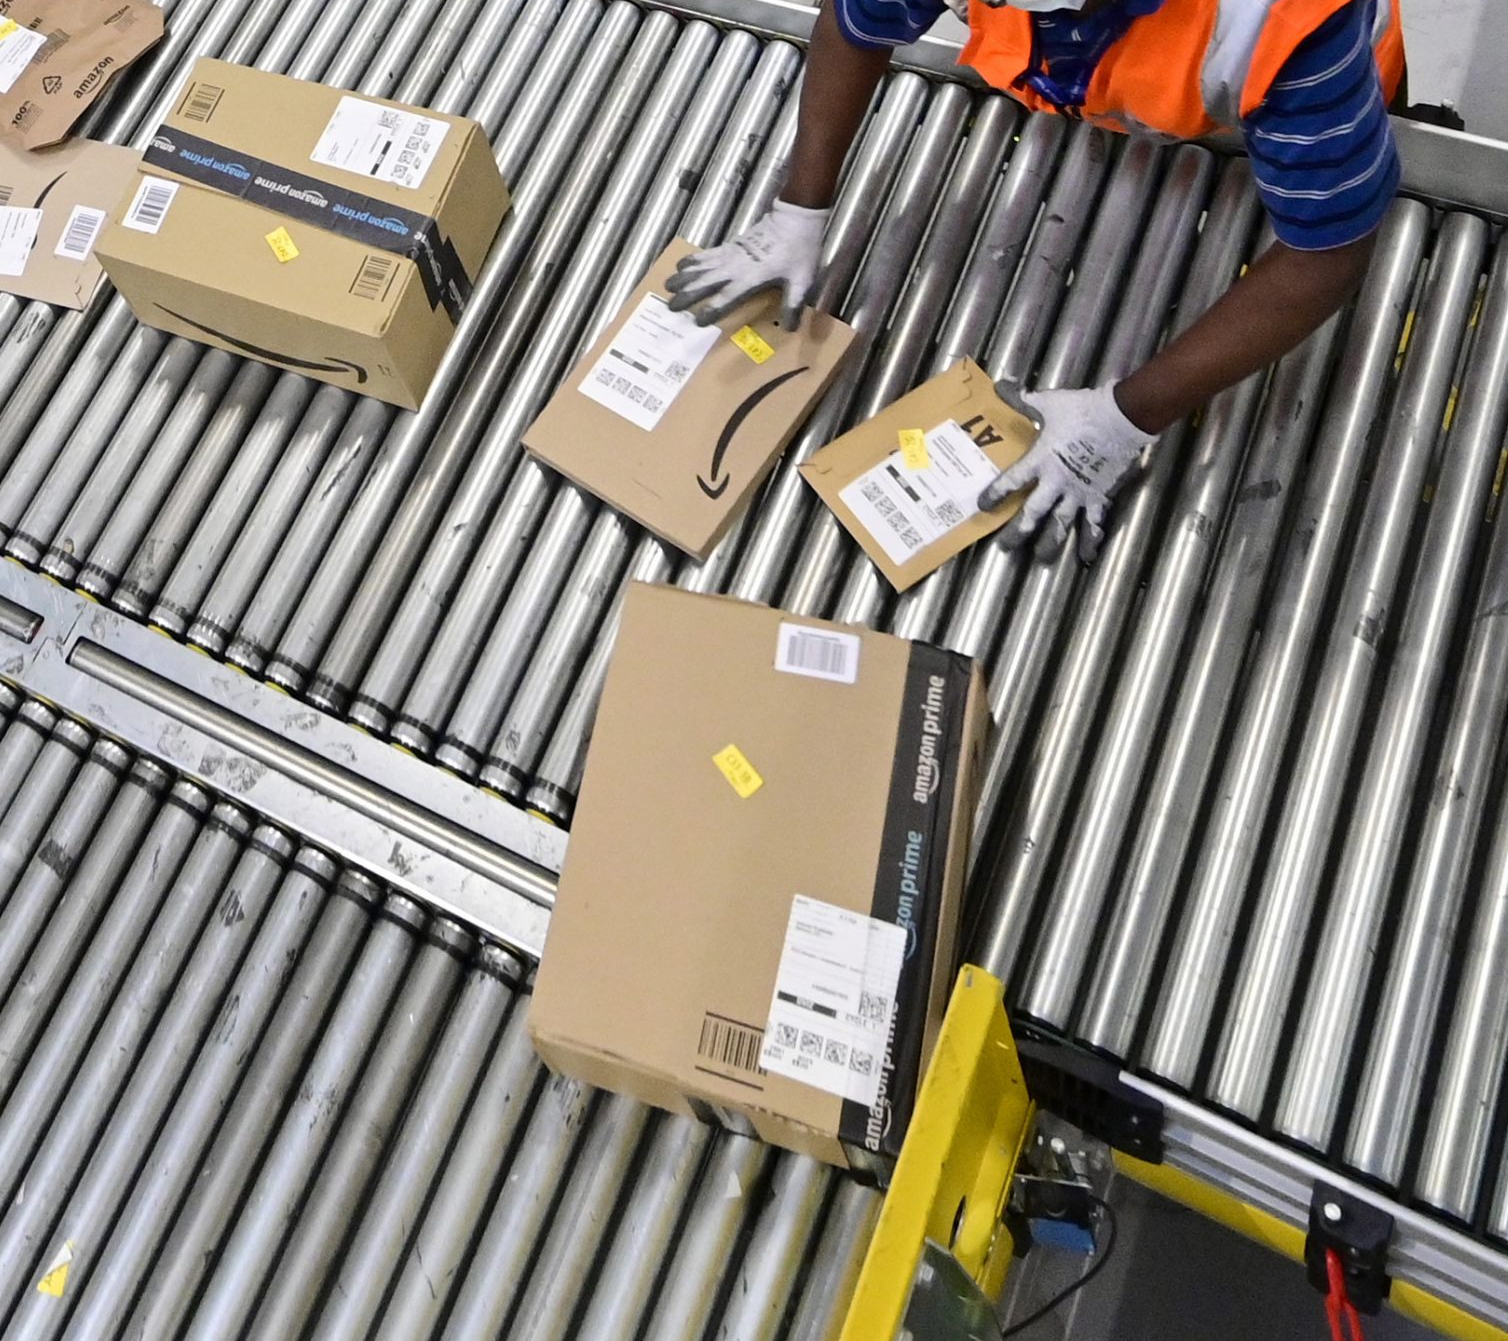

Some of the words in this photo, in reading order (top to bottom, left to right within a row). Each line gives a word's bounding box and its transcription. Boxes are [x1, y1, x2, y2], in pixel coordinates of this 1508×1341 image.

[73, 56, 114, 99] amazon
[180, 149, 217, 170] prime
[215, 162, 250, 181] amazon
[254, 176, 289, 196] prime
[287, 189, 329, 209] amazon
[333, 203, 371, 224] prime
[369, 216, 409, 236] amazon
[961, 414, 1004, 448] A1
[921, 675, 945, 735] prime
[913, 735, 940, 804] amazon
[899, 830, 922, 896] prime
